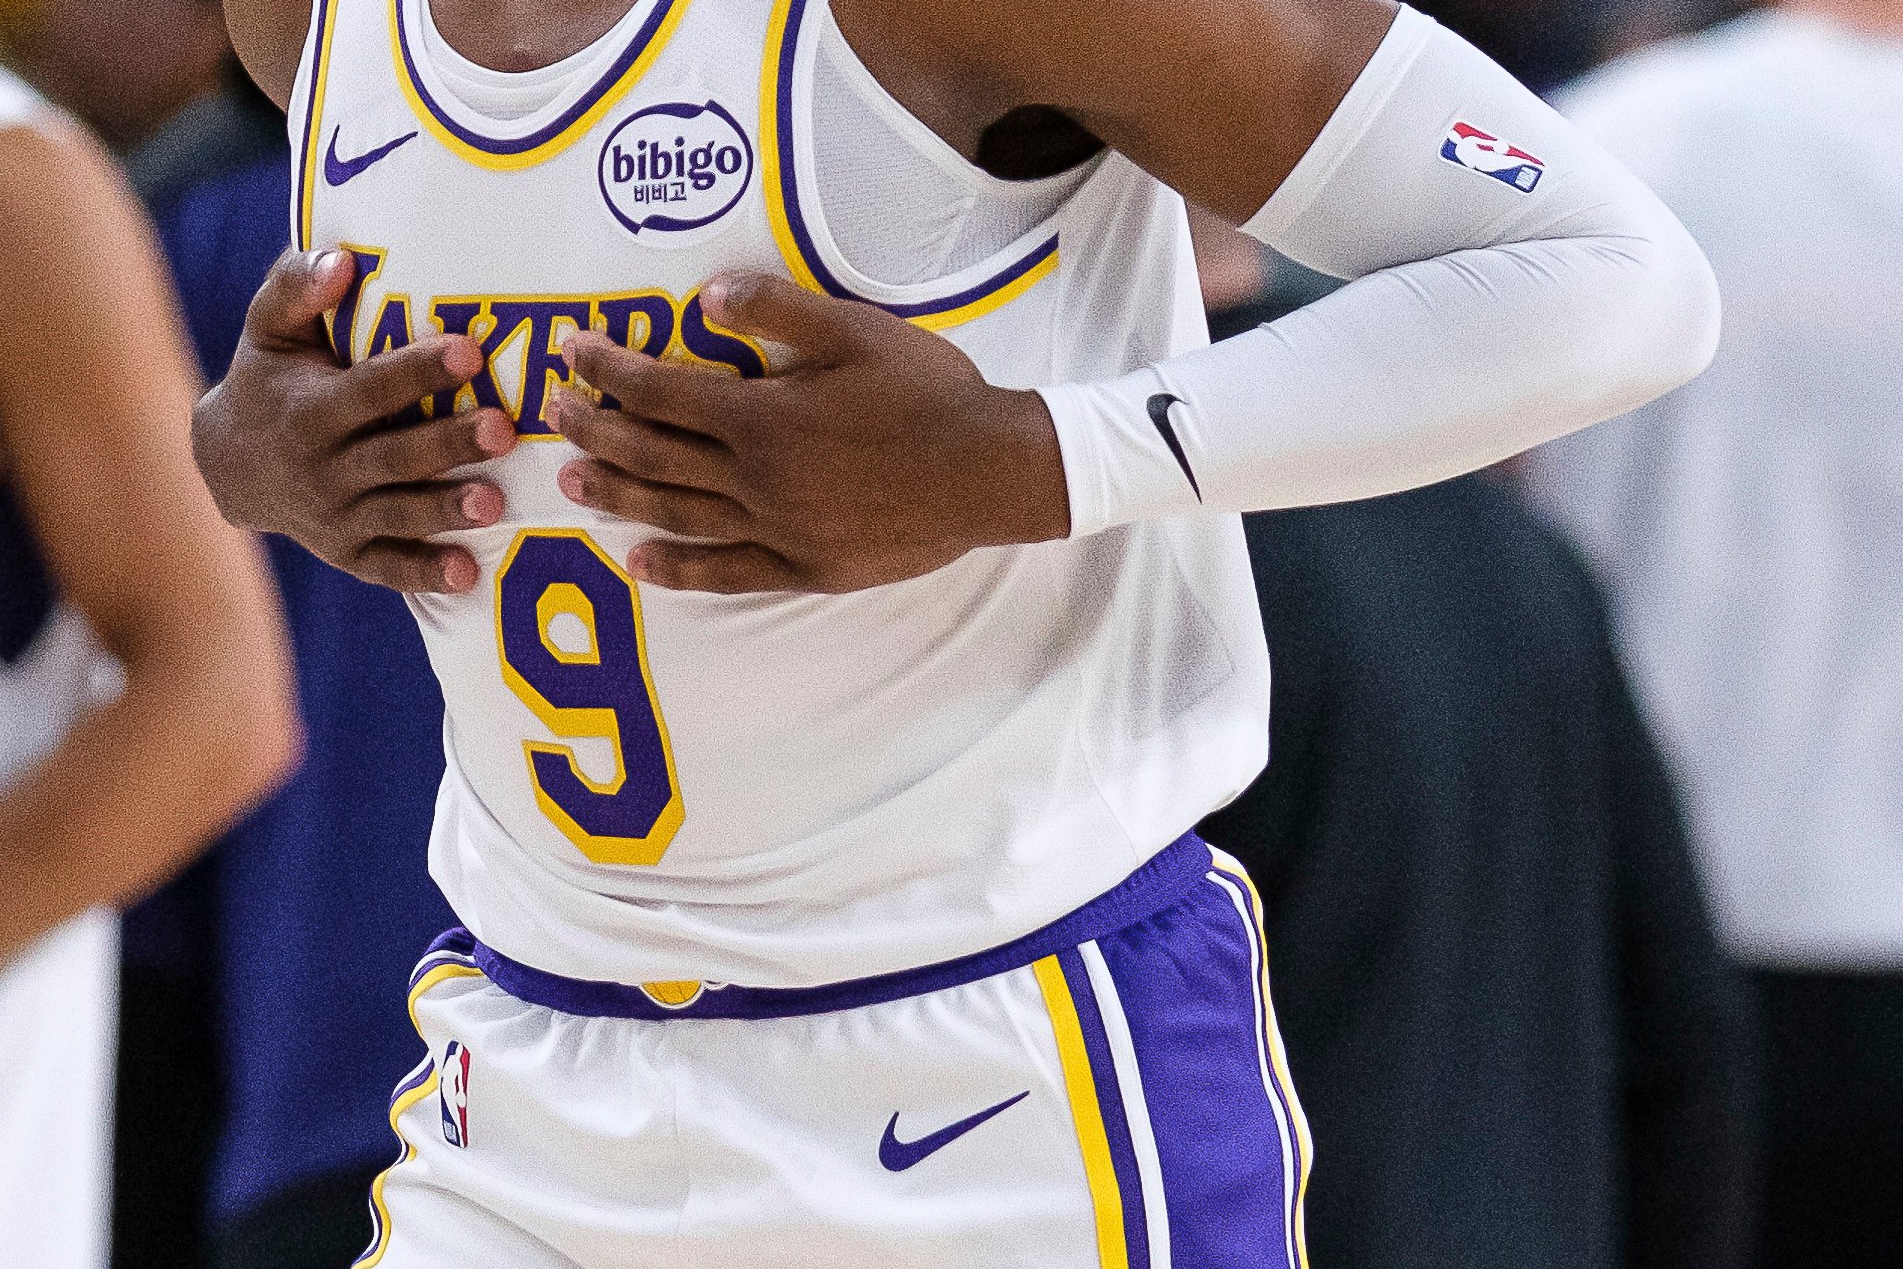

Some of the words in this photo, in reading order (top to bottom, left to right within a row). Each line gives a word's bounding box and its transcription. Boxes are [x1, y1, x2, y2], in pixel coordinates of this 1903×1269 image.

[612, 135, 743, 191] bibigo
[633, 182, 687, 204] 비비고
[493, 527, 687, 866] 9
